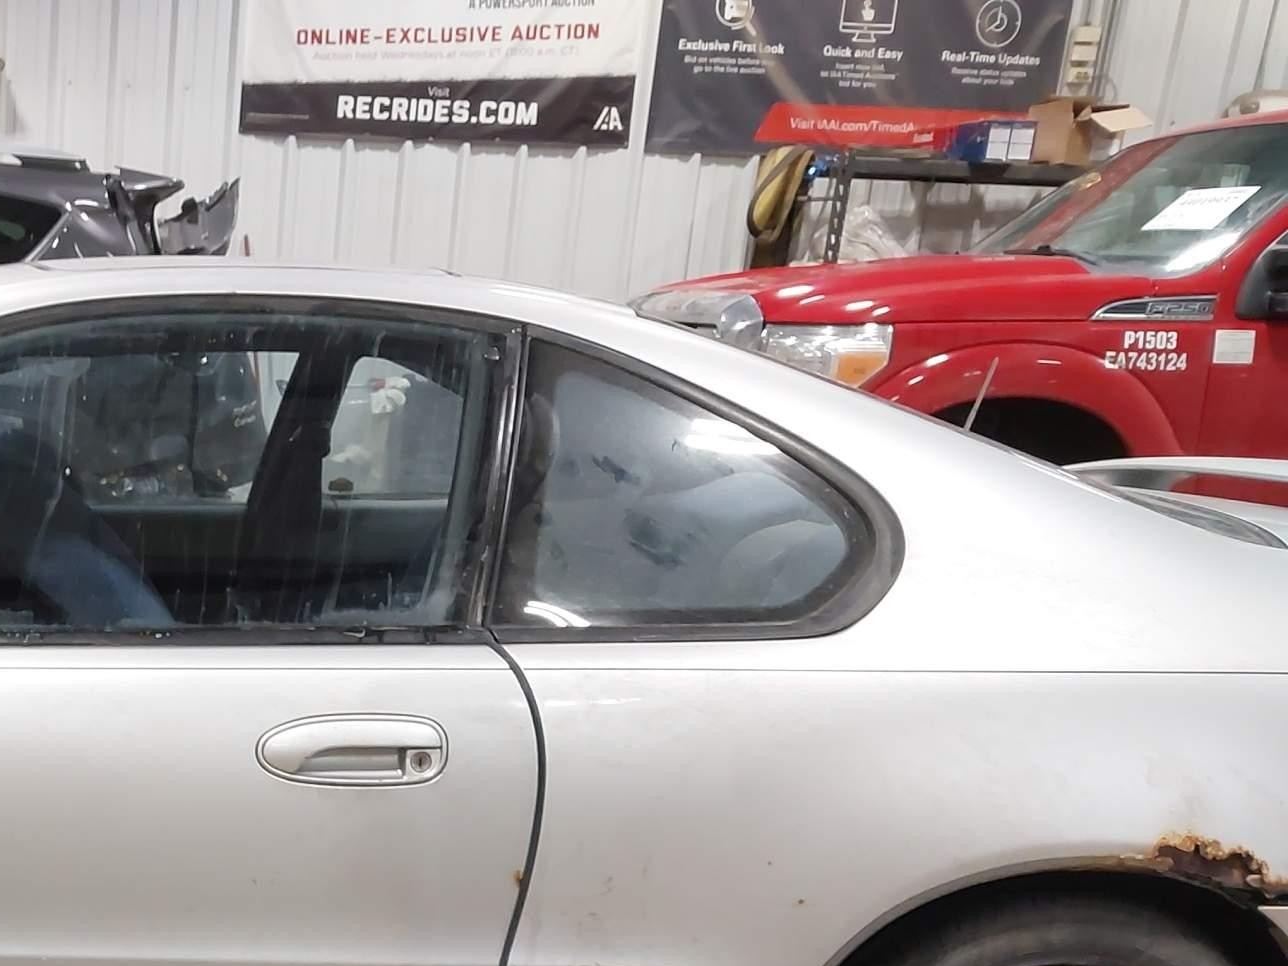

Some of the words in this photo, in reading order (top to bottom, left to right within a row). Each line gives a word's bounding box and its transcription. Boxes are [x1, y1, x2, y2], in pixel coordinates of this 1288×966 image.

[296, 26, 503, 45] ONLINE-EXCLUSIVE
[511, 23, 600, 41] AUCTION
[678, 38, 730, 52] Exclusive
[732, 40, 756, 53] First
[759, 42, 784, 54] Look
[823, 45, 851, 57] Quick
[854, 48, 875, 58] and
[877, 48, 903, 61] Easy
[942, 50, 996, 63] Real-Time
[998, 54, 1040, 66] Updates
[428, 86, 449, 98] Visit
[337, 95, 538, 125] RECRIDES.COM
[790, 118, 814, 130] Visit
[1124, 331, 1178, 349] P1503
[1104, 351, 1187, 371] EA743124
